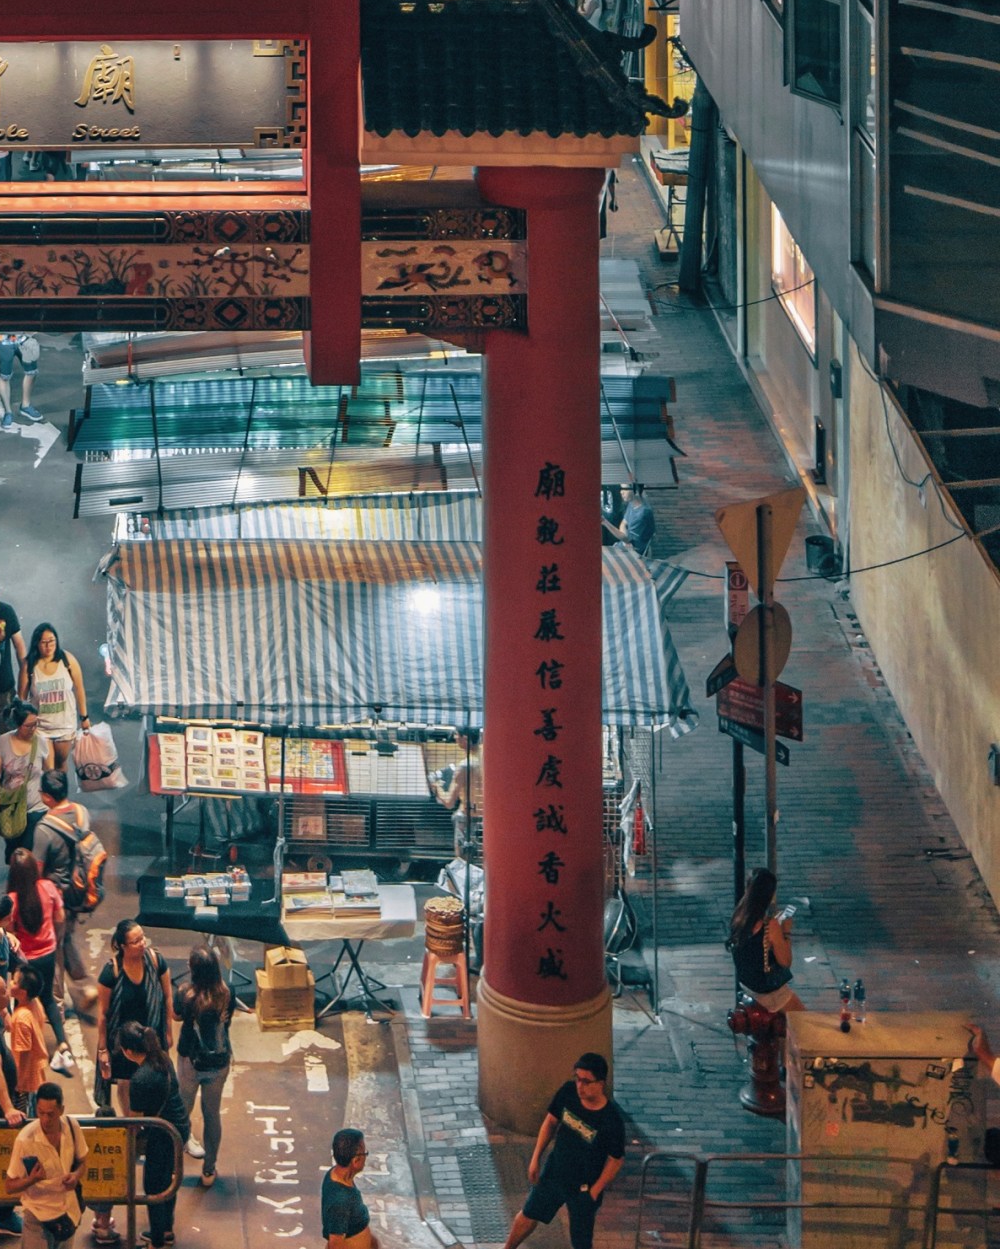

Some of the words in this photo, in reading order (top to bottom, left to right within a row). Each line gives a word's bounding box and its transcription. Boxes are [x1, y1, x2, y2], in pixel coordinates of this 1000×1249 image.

[72, 122, 142, 142] Street
[39, 690, 65, 703] WITH
[93, 1143, 122, 1155] Area
